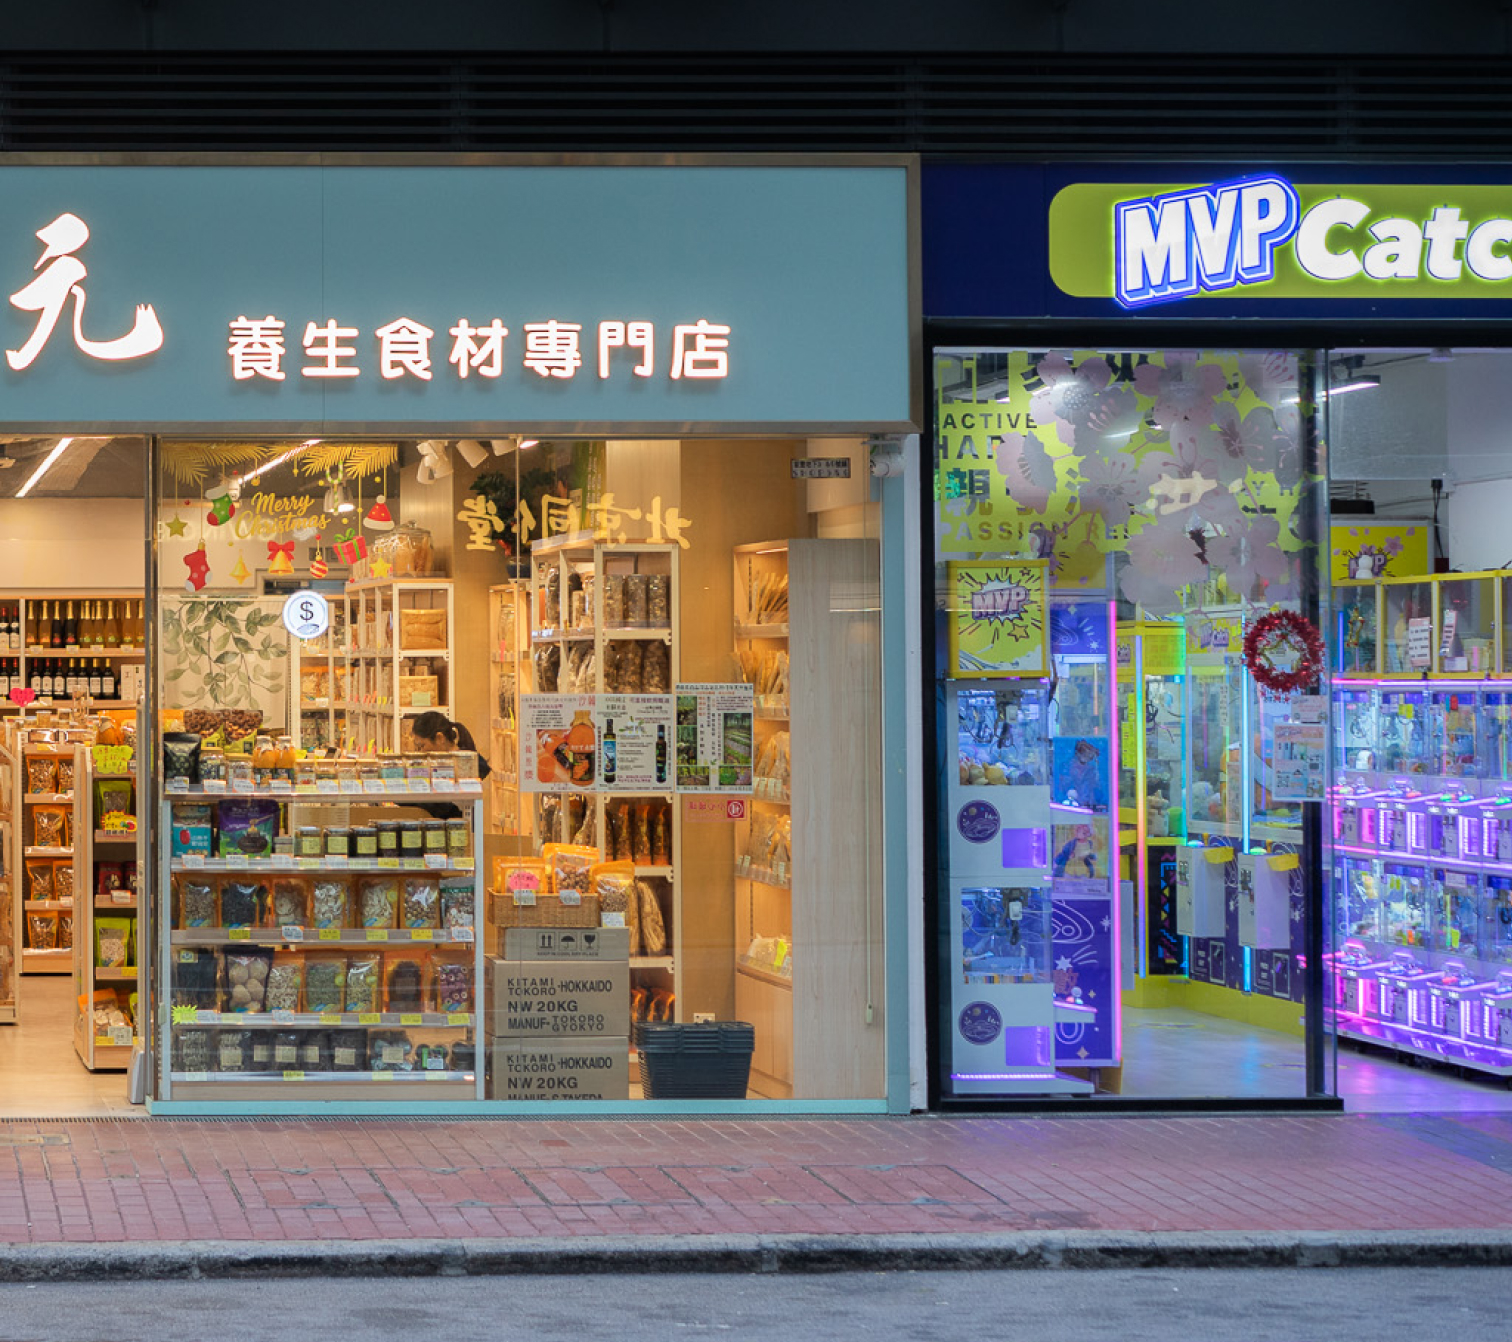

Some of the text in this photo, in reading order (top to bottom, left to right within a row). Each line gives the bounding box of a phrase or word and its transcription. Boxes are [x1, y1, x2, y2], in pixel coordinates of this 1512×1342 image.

[1118, 178, 1298, 305] MVP
[228, 316, 731, 381] 養生食材專門店
[943, 412, 1038, 429] ACTIVE
[251, 491, 314, 527] Merry
[234, 511, 331, 543] Christmas
[972, 585, 1030, 621] MVP
[508, 978, 555, 987] KITAMI
[508, 987, 556, 996] TOKORO
[508, 1000, 578, 1013] NW 20KG
[552, 1014, 605, 1023] TOKORO
[551, 1023, 605, 1032] GYOKYO
[507, 1054, 554, 1064] KITAMI
[508, 1064, 556, 1073] TOKORO
[508, 1077, 578, 1089] NW 20KG
